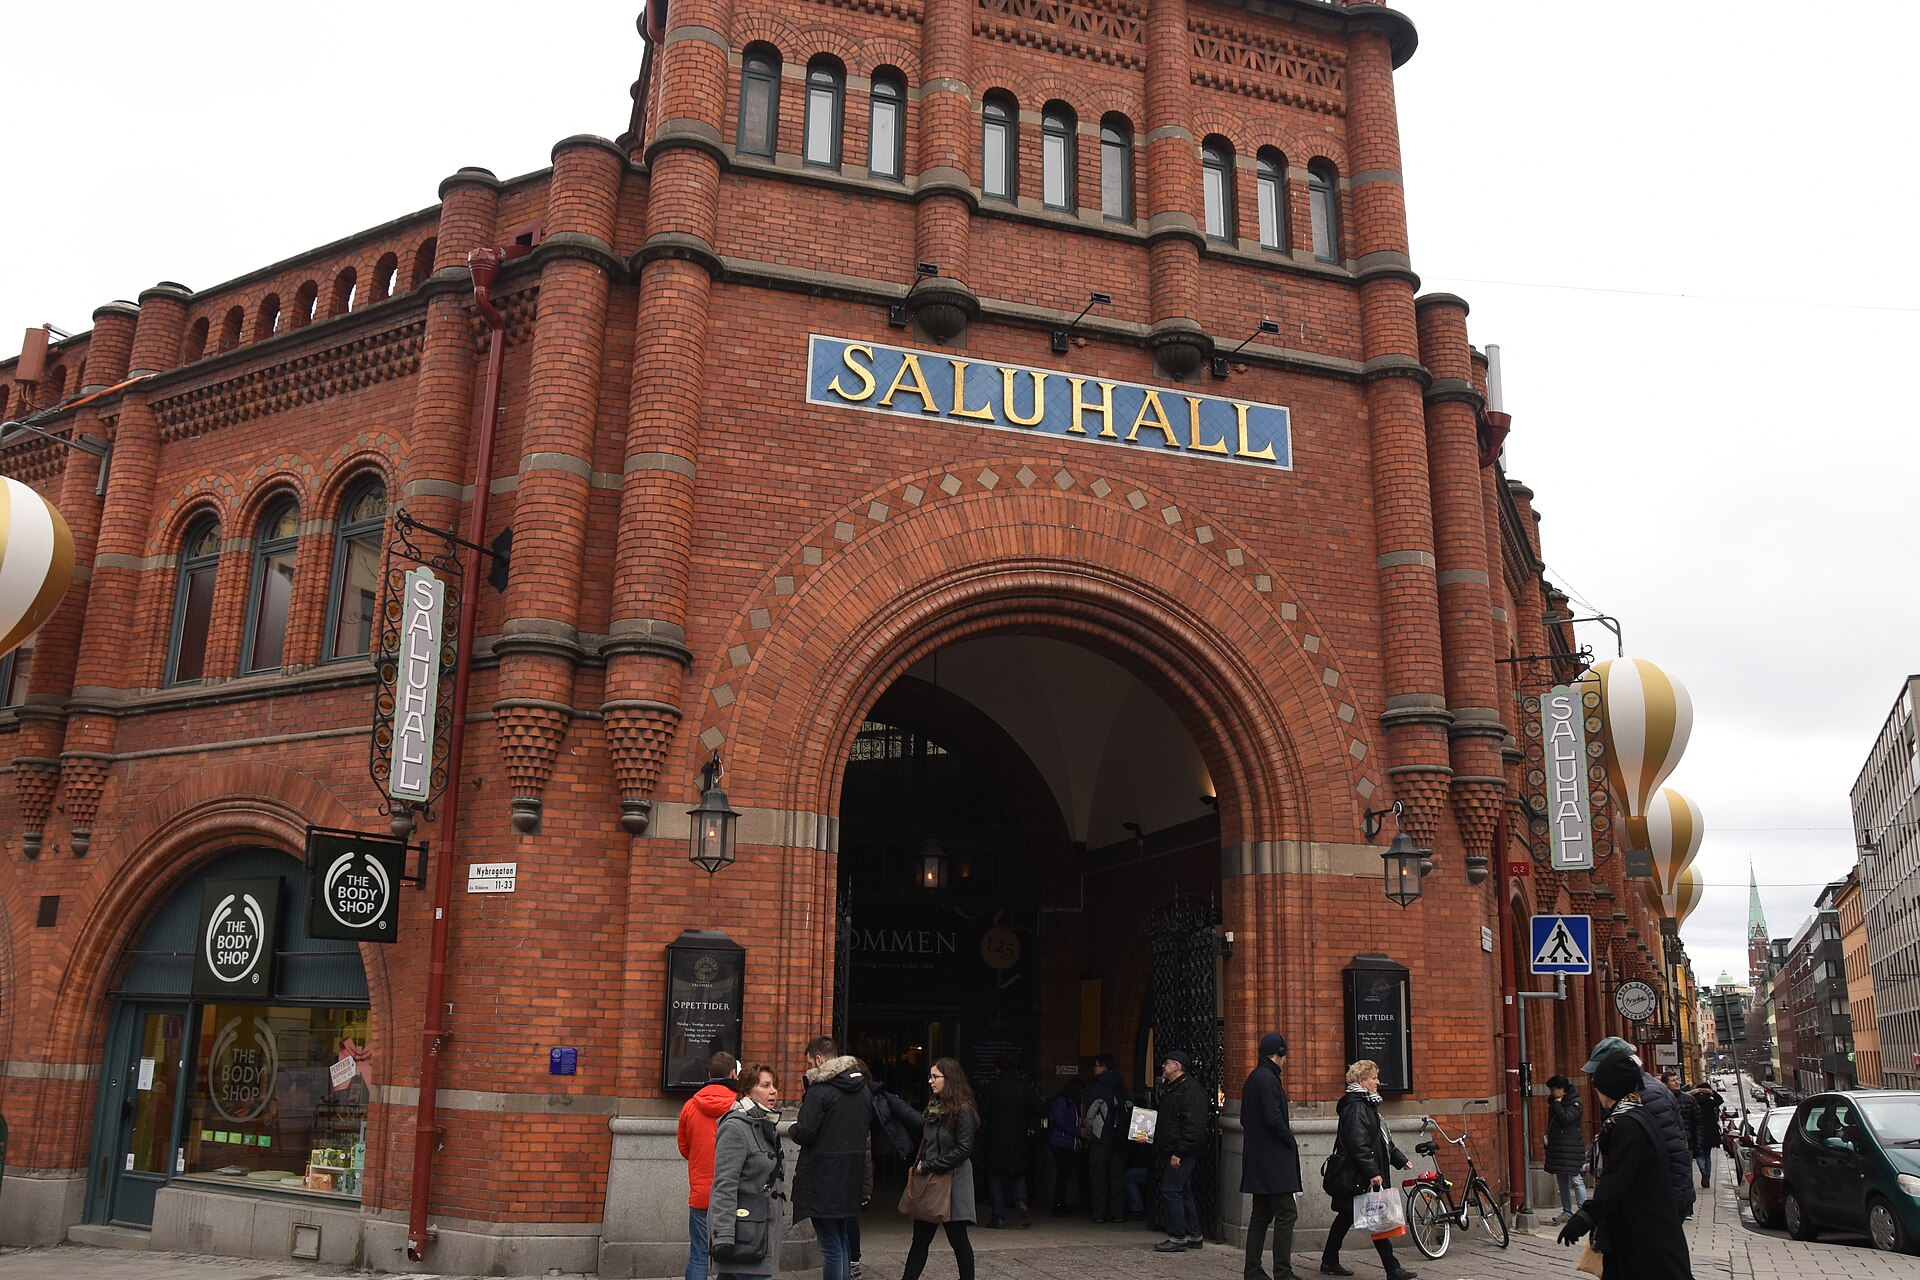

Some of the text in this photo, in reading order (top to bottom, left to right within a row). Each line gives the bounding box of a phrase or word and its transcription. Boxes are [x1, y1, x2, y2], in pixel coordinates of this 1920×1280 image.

[827, 344, 1277, 461] SALUHALL
[399, 578, 434, 791] SALUHALL
[1550, 696, 1584, 863] SALUHALL
[476, 866, 514, 878] Nybrogatan
[346, 874, 369, 887] THE
[495, 880, 513, 889] 11-33
[337, 886, 378, 901] BODY
[339, 900, 375, 914] SHOP
[226, 920, 246, 933] THE
[217, 934, 253, 949] BODY
[985, 936, 1014, 961] 125
[216, 951, 249, 965] SHOP
[1617, 983, 1654, 1000] BRUKA DESIGN
[672, 1000, 730, 1011] ÖPPETTIDER
[1620, 1006, 1653, 1018] STOCKHOLM
[232, 1048, 256, 1064] THE
[221, 1065, 264, 1083] BODY
[221, 1085, 259, 1102] SHOP
